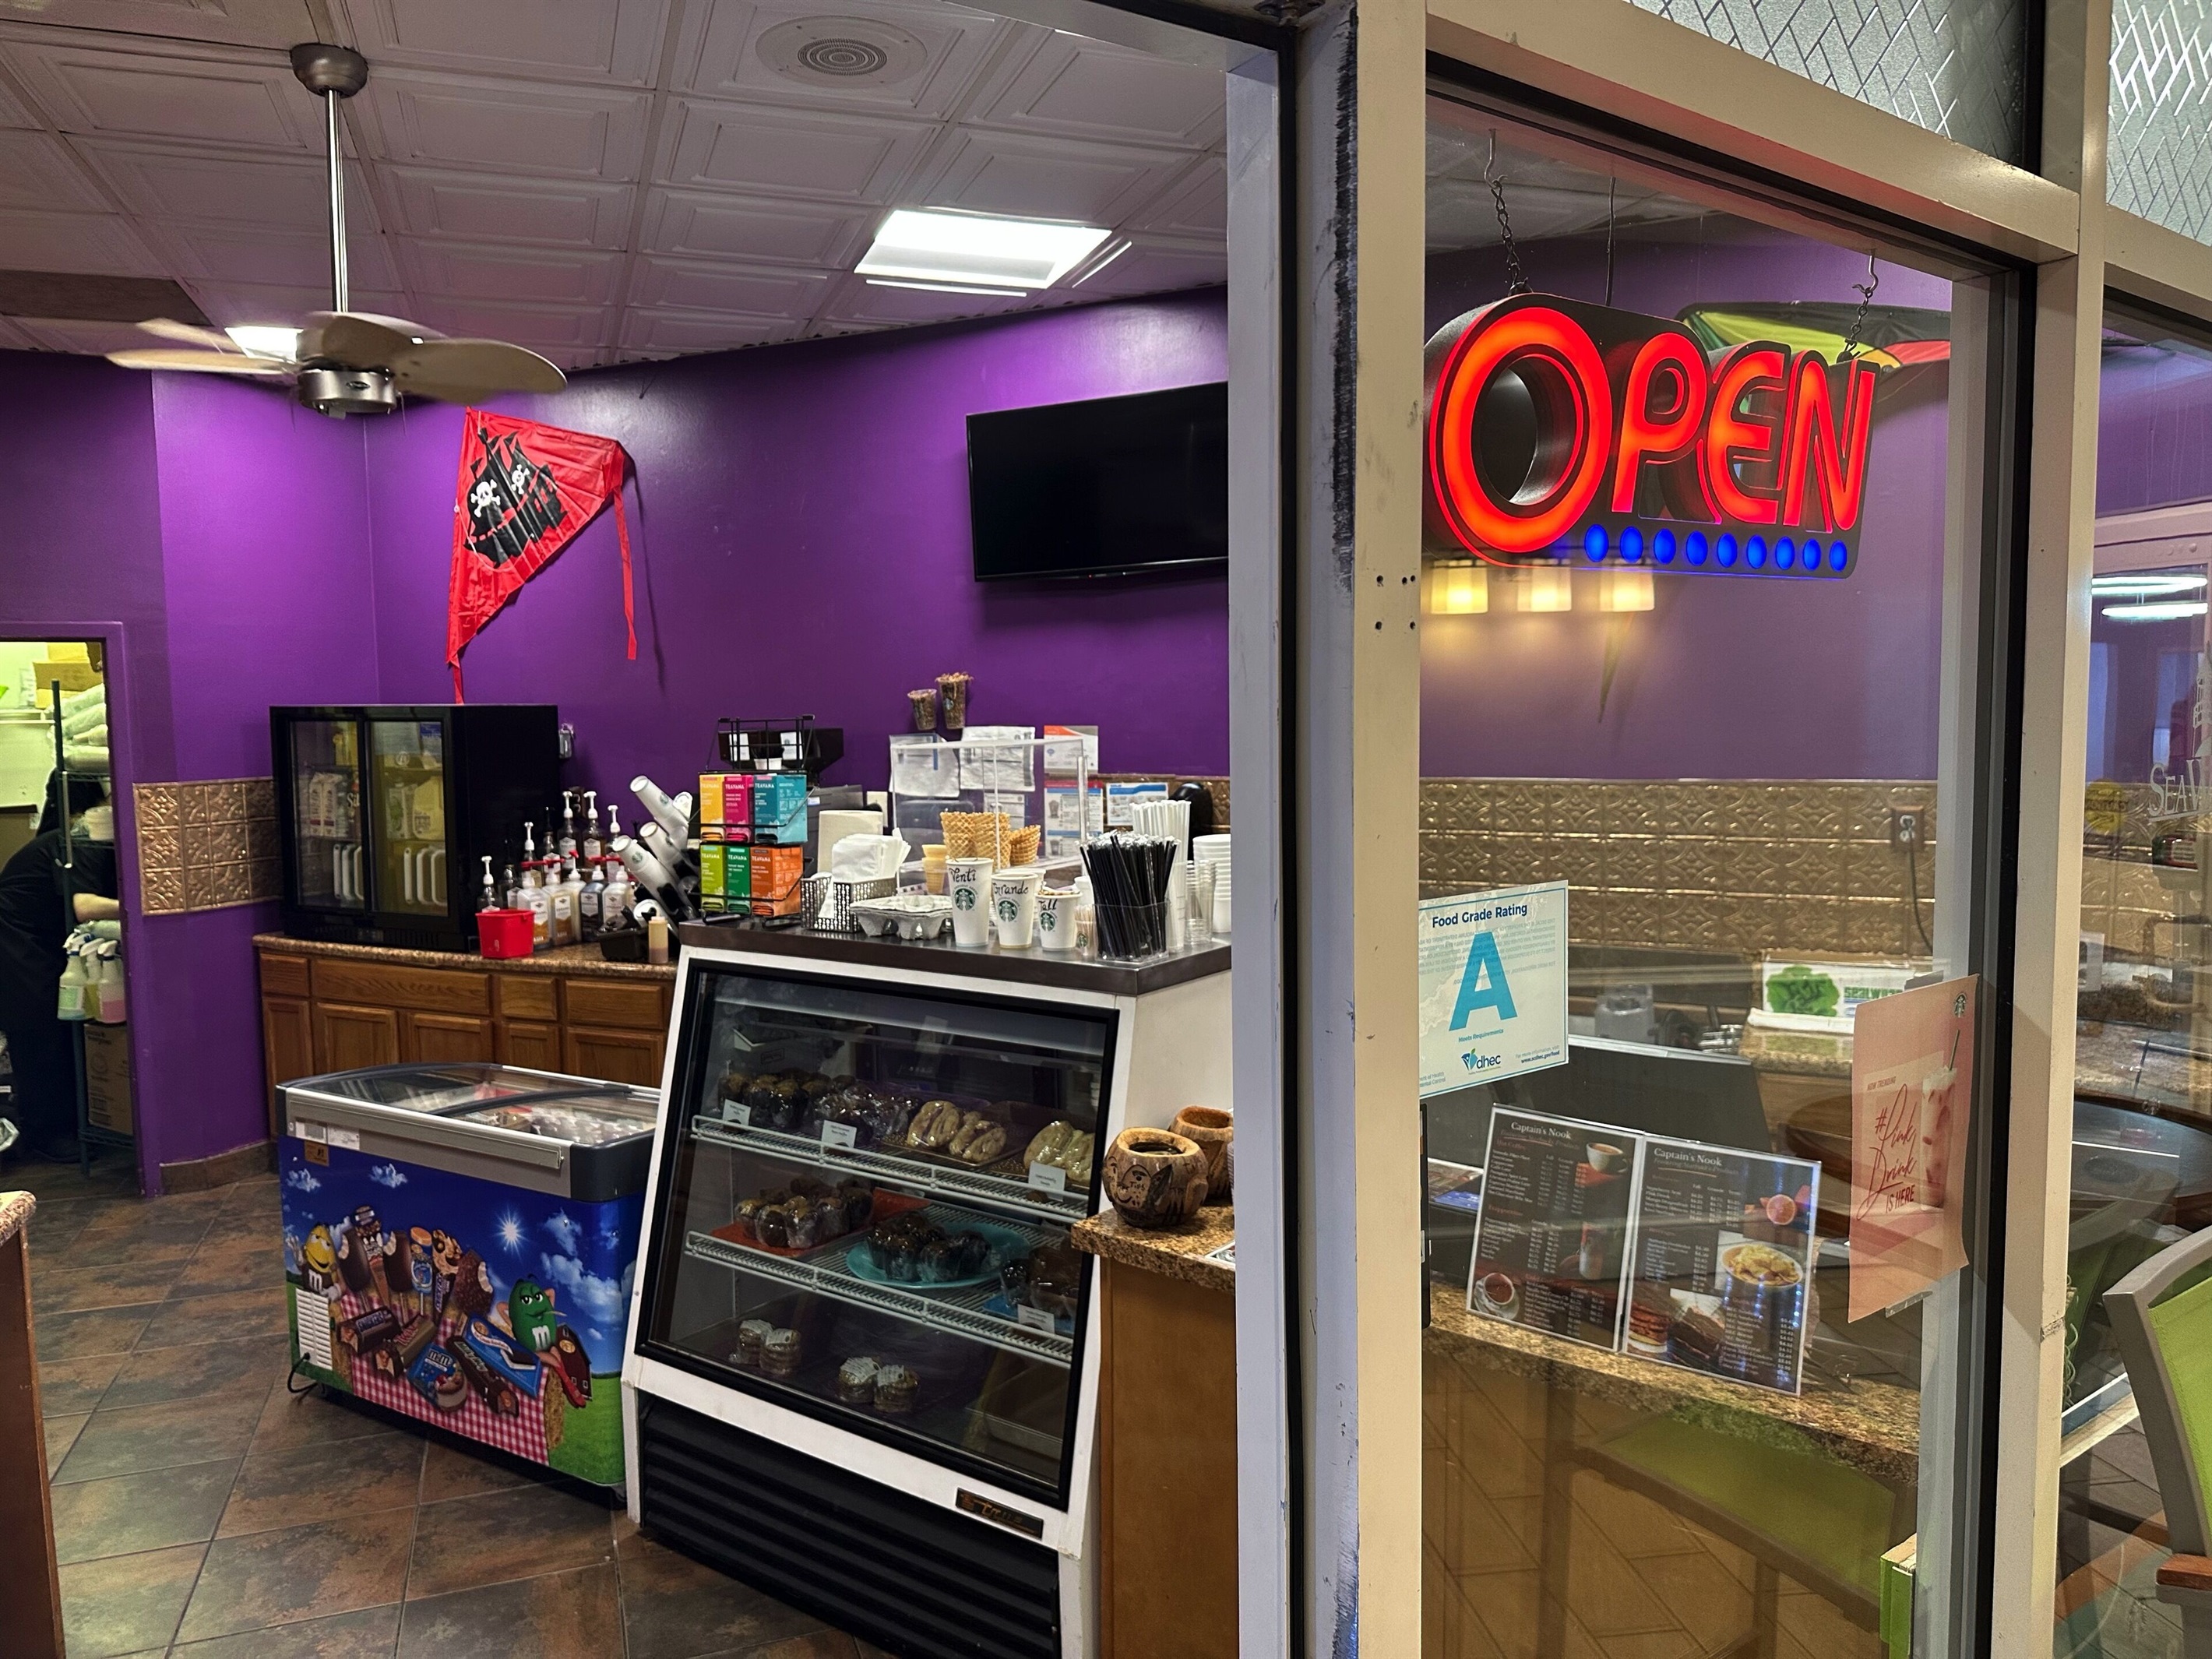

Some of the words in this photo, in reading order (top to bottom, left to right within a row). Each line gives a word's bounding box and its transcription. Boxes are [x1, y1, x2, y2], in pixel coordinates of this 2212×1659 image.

[1430, 307, 1875, 554] OPEN
[949, 868, 977, 882] Venti
[992, 881, 1029, 896] Grande
[1038, 899, 1058, 911] Tall
[1432, 914, 1459, 928] Food
[1462, 908, 1492, 923] Grade
[1495, 903, 1527, 918] Rating
[1449, 932, 1518, 1031] A
[1477, 1054, 1502, 1069] dhec
[1511, 1122, 1547, 1136] Captain's
[1548, 1128, 1572, 1139] Nook
[1654, 1147, 1695, 1161] Captain's
[1697, 1154, 1722, 1167] Nook
[1886, 1194, 1894, 1213] IS
[1895, 1185, 1915, 1210] HERE
